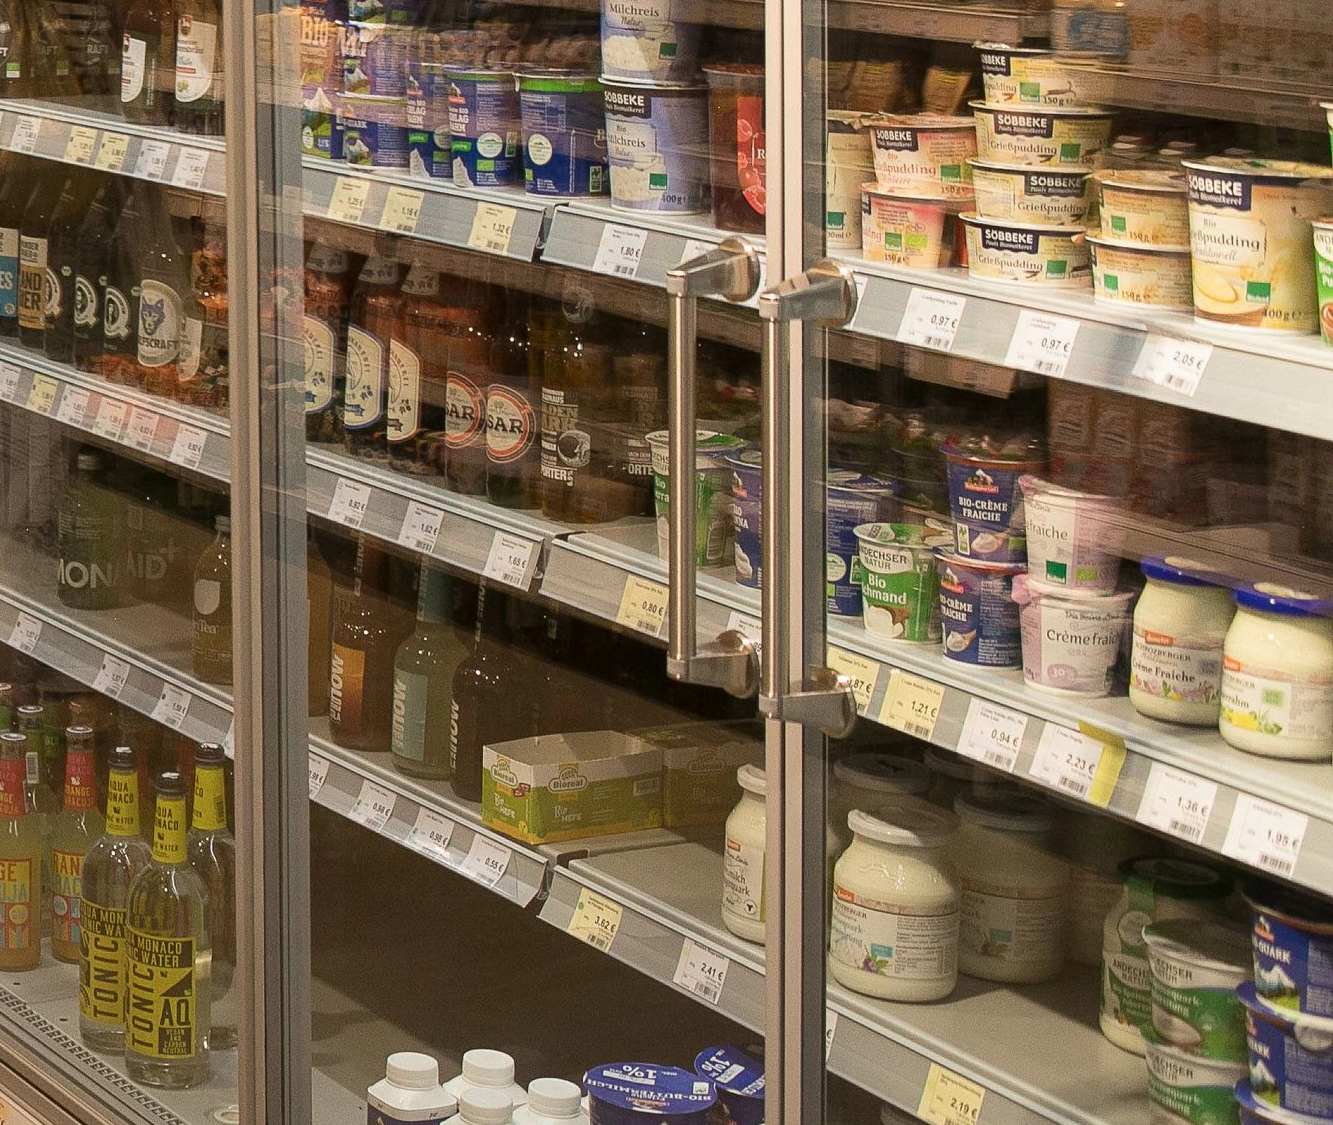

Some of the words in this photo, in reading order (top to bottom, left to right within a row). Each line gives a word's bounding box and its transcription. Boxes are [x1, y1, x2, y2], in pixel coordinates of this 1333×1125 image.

[609, 3, 660, 17] Milchreis
[605, 90, 645, 107] SÖBBEKE
[998, 114, 1047, 127] SÖBBEKE
[990, 141, 1057, 155] Grießpudding
[1030, 175, 1081, 189] SÖBBEKE
[1188, 175, 1242, 196] SÖBBEKE
[985, 230, 1033, 244] SÖBBEKE
[620, 245, 635, 257] 1,80
[978, 256, 1043, 270] Grießpudding
[931, 314, 949, 327] 0,97
[951, 319, 957, 329] €
[1040, 337, 1061, 350] 0,97
[1063, 342, 1070, 353] €
[1172, 351, 1195, 367] 2,05
[1197, 358, 1205, 370] €
[958, 496, 1008, 513] BIO-CRÈME
[962, 507, 1001, 522] FRAICHE
[865, 557, 891, 571] NATUR
[868, 573, 886, 589] Bio
[642, 601, 657, 614] 0,80
[1046, 629, 1091, 645] Crème
[1155, 666, 1196, 683] Fraiche
[910, 699, 928, 715] 1,21
[930, 706, 938, 719] €
[990, 729, 1010, 744] 0,94
[1012, 736, 1019, 748] €
[1065, 753, 1086, 770] 2,23
[1087, 762, 1096, 775] €
[553, 777, 584, 791] Bioreal
[155, 805, 173, 819] QUA
[1177, 795, 1198, 813] 1,36
[1200, 803, 1208, 817] €
[1291, 835, 1299, 850] €
[595, 916, 610, 930] 3,62
[610, 924, 615, 932] €
[137, 939, 182, 955] MONACO
[142, 953, 179, 967] WATER
[93, 937, 119, 1019] TONIC
[701, 963, 716, 977] 2,41
[718, 971, 724, 981] €
[133, 967, 154, 1050] TONIC
[950, 1097, 970, 1114] 2,19
[971, 1108, 978, 1120] €
